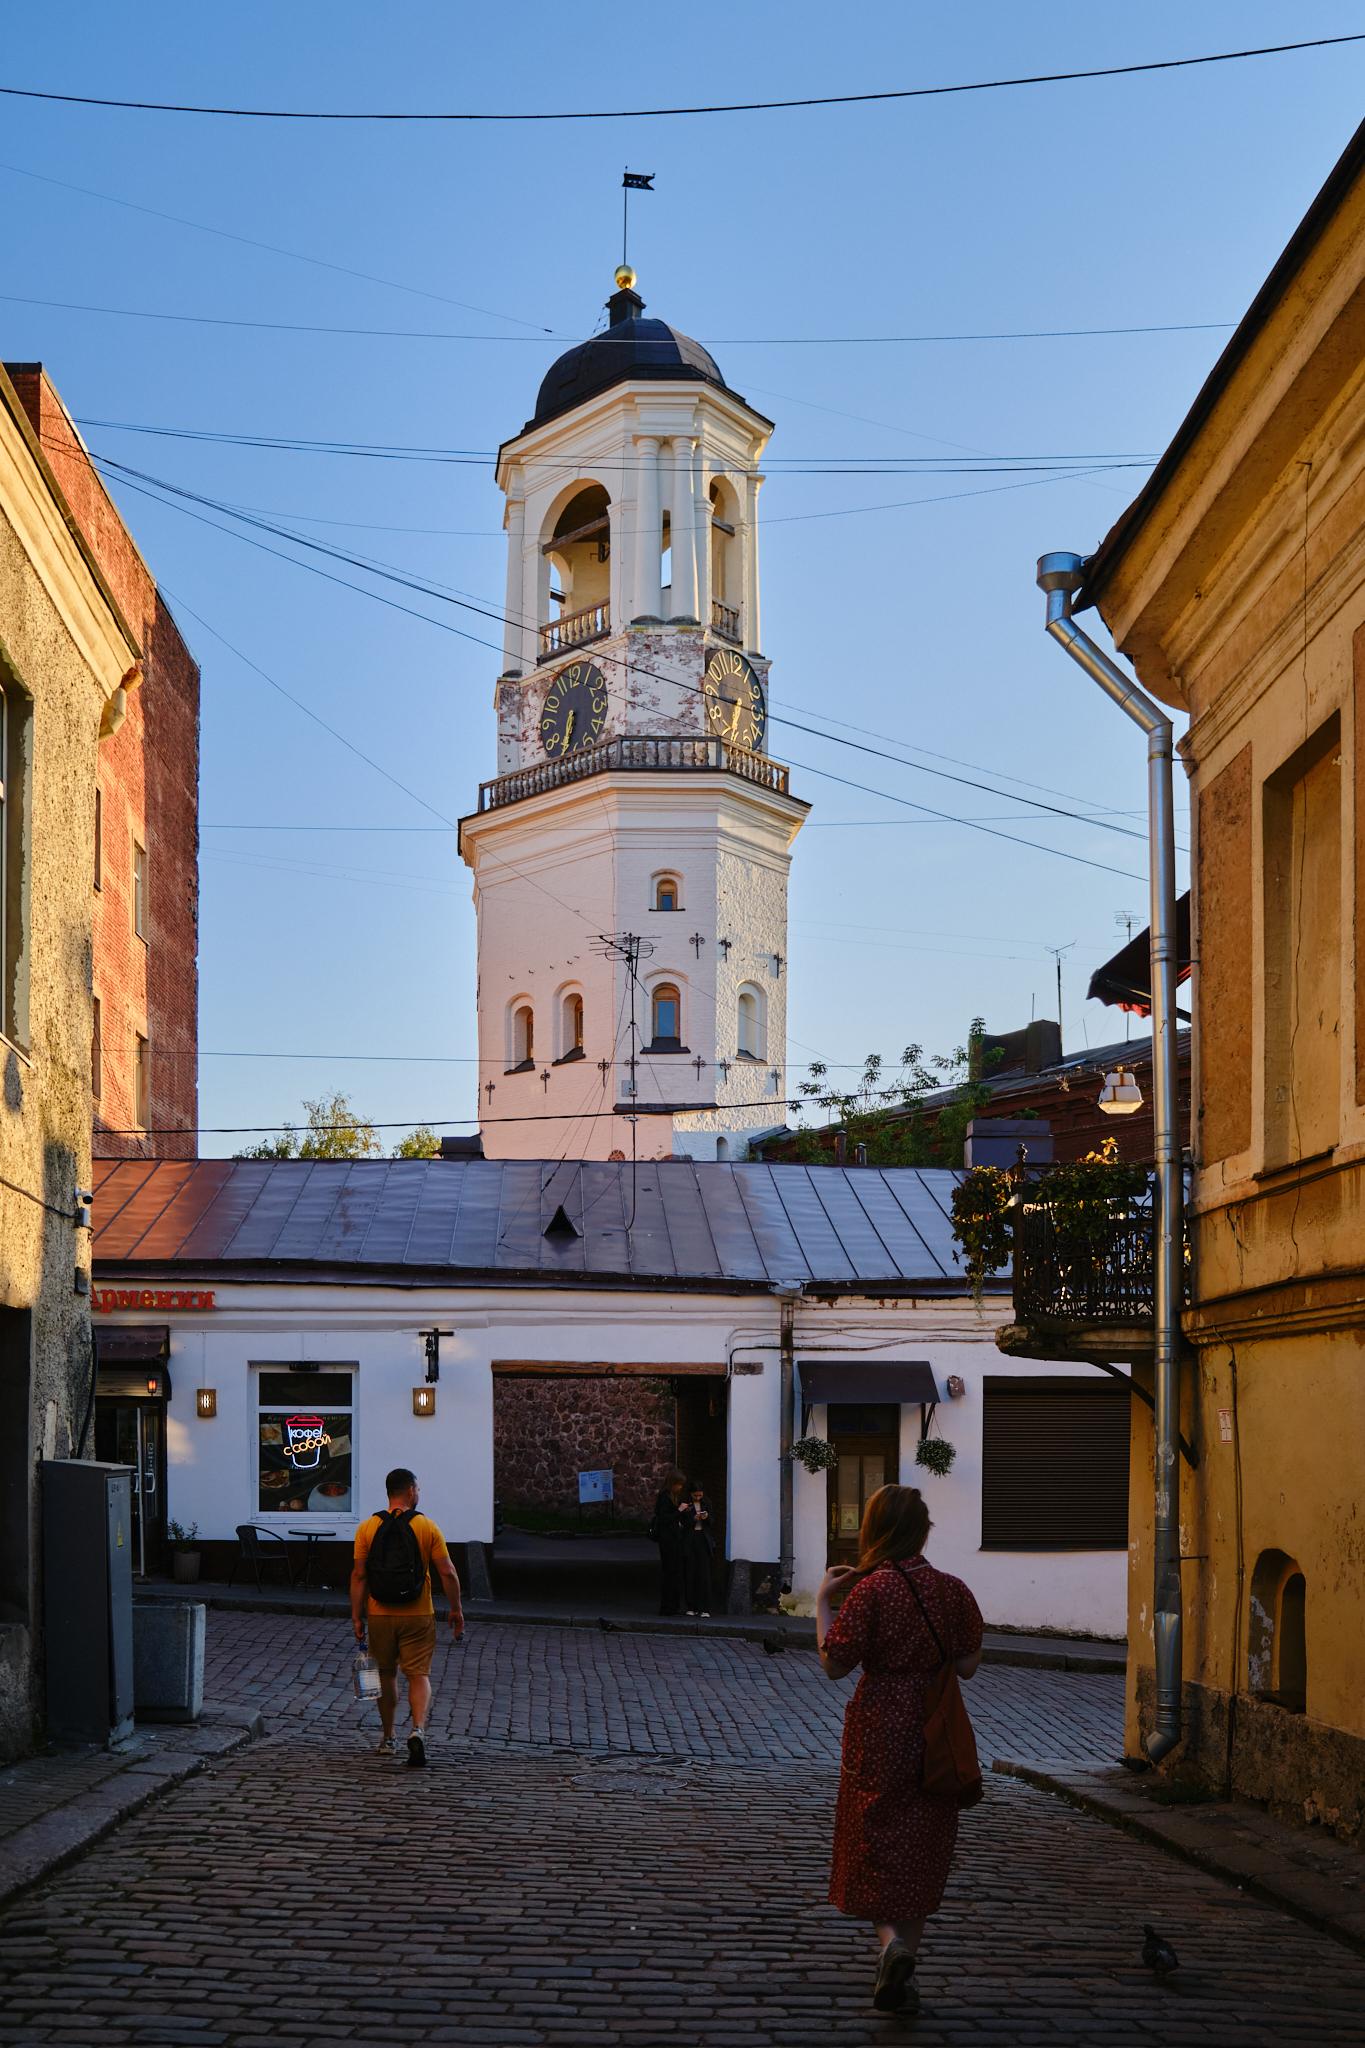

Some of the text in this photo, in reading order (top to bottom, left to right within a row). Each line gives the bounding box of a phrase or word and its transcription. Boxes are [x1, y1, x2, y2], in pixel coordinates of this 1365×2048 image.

[708, 661, 722, 686] 10
[730, 651, 742, 677] 12
[569, 665, 581, 688] 12
[584, 665, 592, 686] 1
[744, 668, 751, 684] 1
[556, 676, 567, 696] 11
[589, 676, 604, 697] 2
[705, 684, 719, 698] 9
[749, 685, 761, 701] 2
[544, 695, 560, 714] 10
[592, 695, 607, 714] 3
[709, 705, 722, 720] 8
[750, 704, 764, 722] 3
[542, 718, 557, 730] 9
[591, 717, 604, 734] 4
[750, 721, 763, 741] 4
[545, 733, 560, 751] 8
